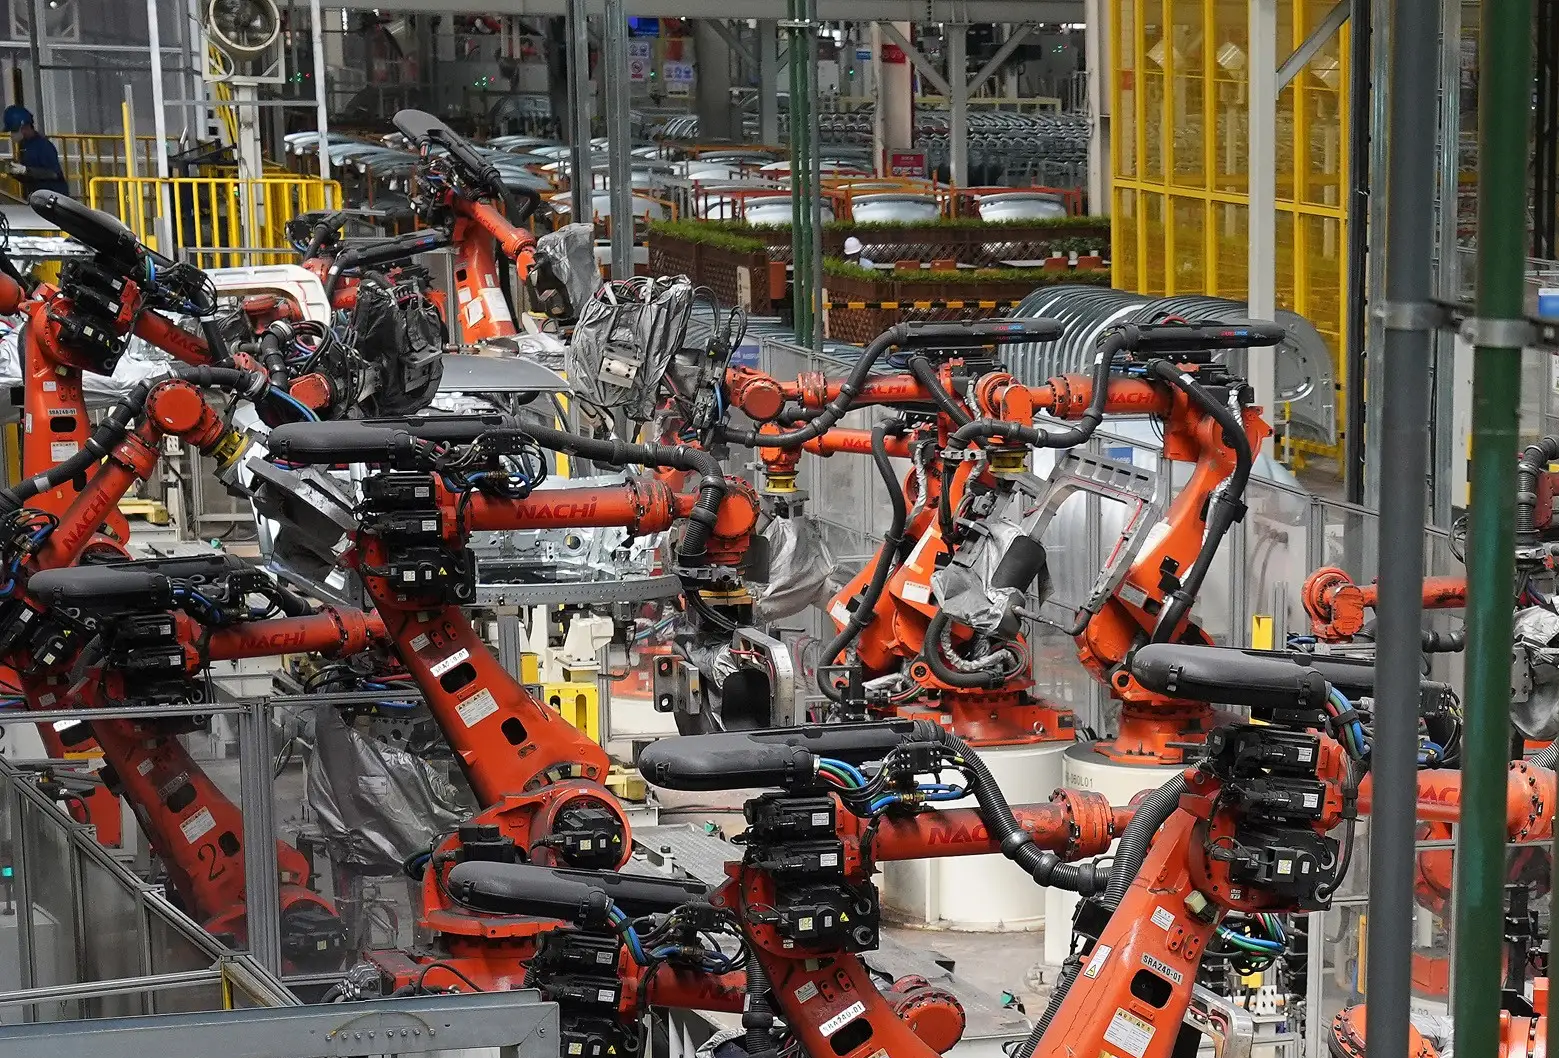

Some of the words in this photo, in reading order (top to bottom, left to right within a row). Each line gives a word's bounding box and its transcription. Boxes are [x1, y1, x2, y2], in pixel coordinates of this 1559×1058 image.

[842, 437, 871, 448] NAC
[62, 489, 111, 550] NACHI
[516, 498, 597, 519] NACHI
[239, 627, 306, 650] NACHI
[928, 824, 990, 845] NAC
[197, 843, 226, 881] 2
[1143, 953, 1182, 983] SRA240-01
